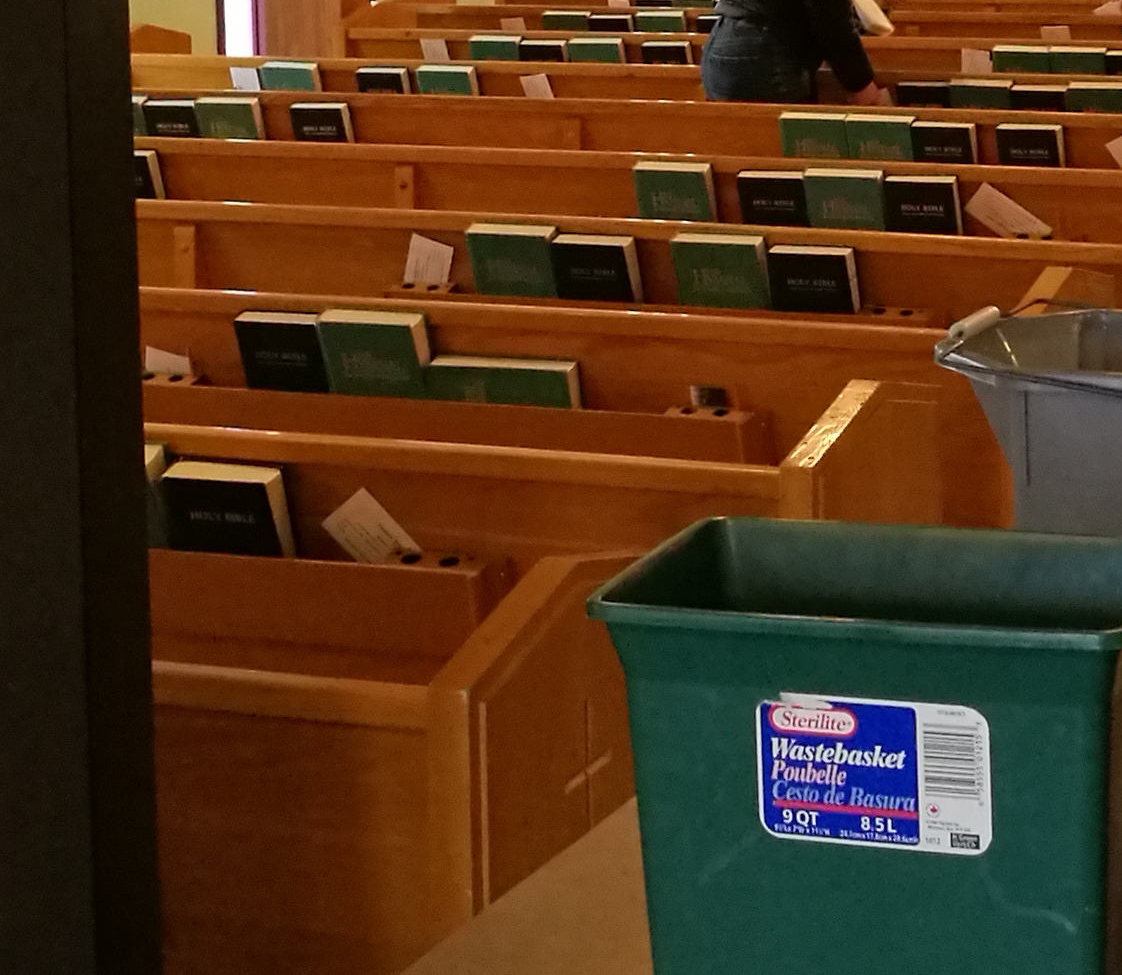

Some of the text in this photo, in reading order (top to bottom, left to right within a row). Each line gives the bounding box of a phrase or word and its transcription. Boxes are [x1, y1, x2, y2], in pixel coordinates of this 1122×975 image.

[781, 710, 847, 731] Sterilite
[770, 736, 906, 770] Wastebasket
[771, 759, 847, 786] Poubelle
[772, 780, 916, 812] Cesto de Basura
[782, 808, 820, 828] 9 QT
